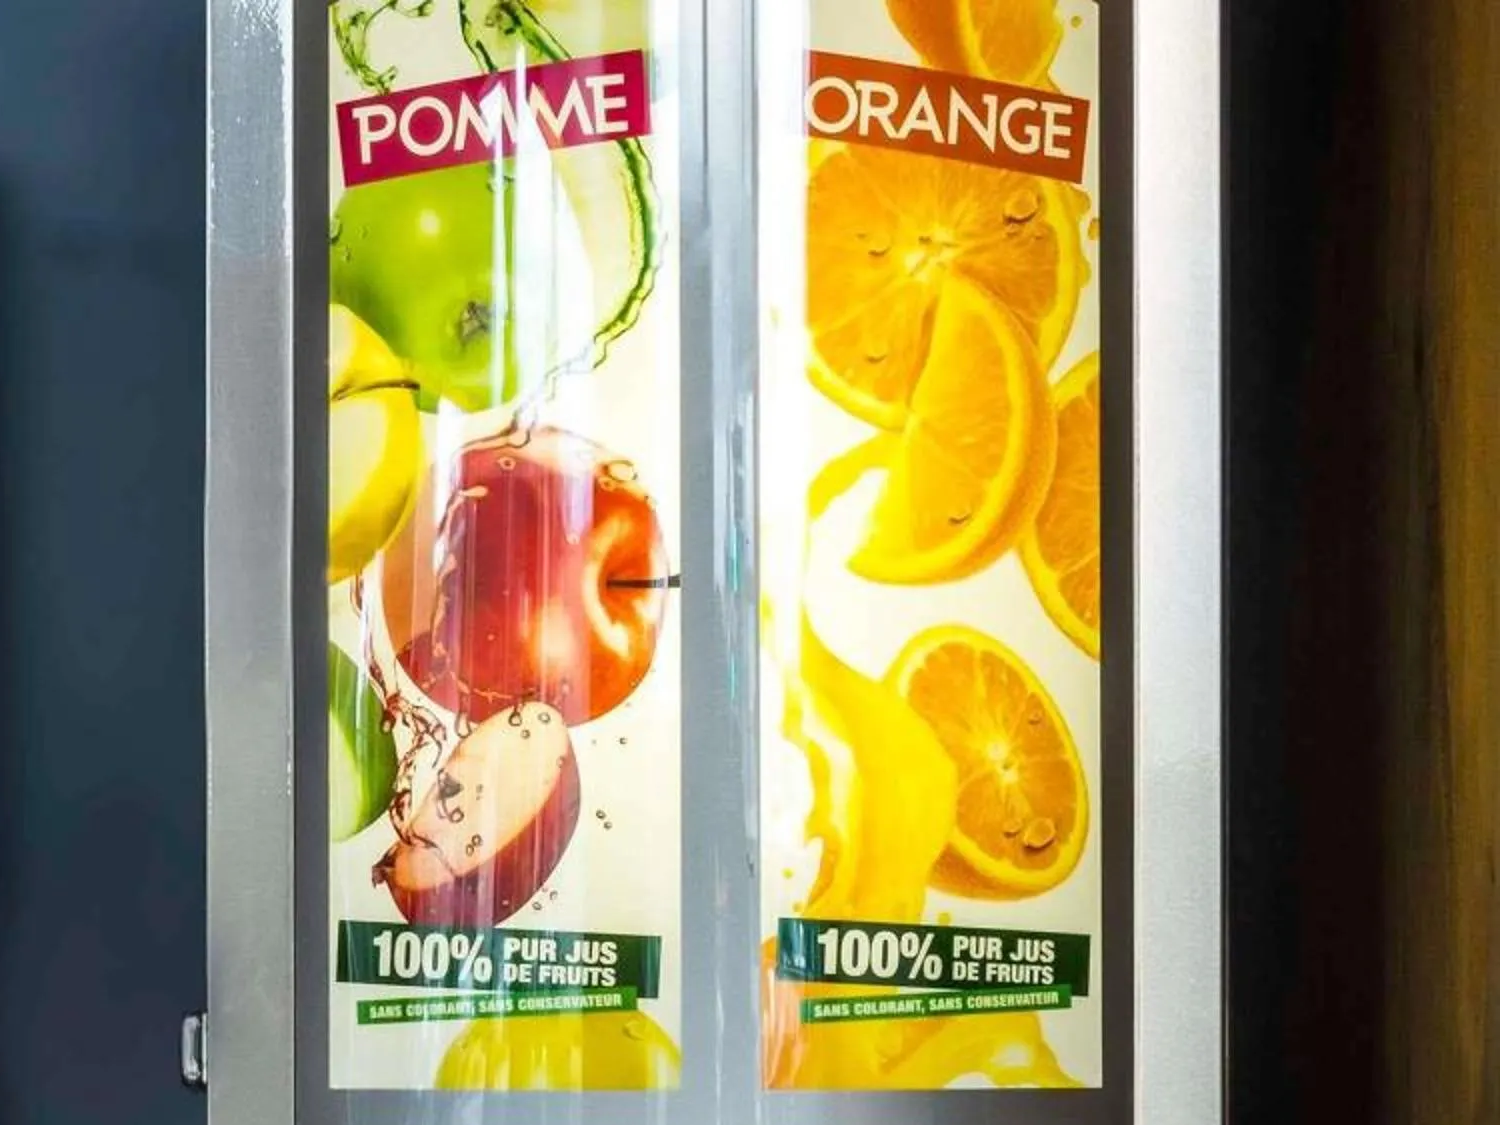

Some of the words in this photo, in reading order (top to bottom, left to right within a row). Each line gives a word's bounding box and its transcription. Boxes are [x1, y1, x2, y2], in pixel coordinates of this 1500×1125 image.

[351, 73, 629, 166] POMME
[804, 76, 1074, 160] ORANGE
[373, 930, 493, 983] 100%
[503, 937, 557, 962] PUR
[566, 940, 618, 965] JUS
[818, 928, 943, 981] 100%
[953, 934, 1003, 960] PUR
[1009, 938, 1055, 963] JUS
[952, 961, 980, 981] DE
[985, 963, 1055, 984] FRUITS
[503, 963, 532, 983] DE
[539, 965, 618, 987] FRUITS
[370, 1004, 402, 1019] SANS
[518, 993, 622, 1011] CONSERVATEUR
[814, 1004, 850, 1018] SANS
[854, 999, 925, 1015] COLORANT,
[929, 996, 963, 1011] SANS
[967, 991, 1060, 1008] CONSERVATEUR
